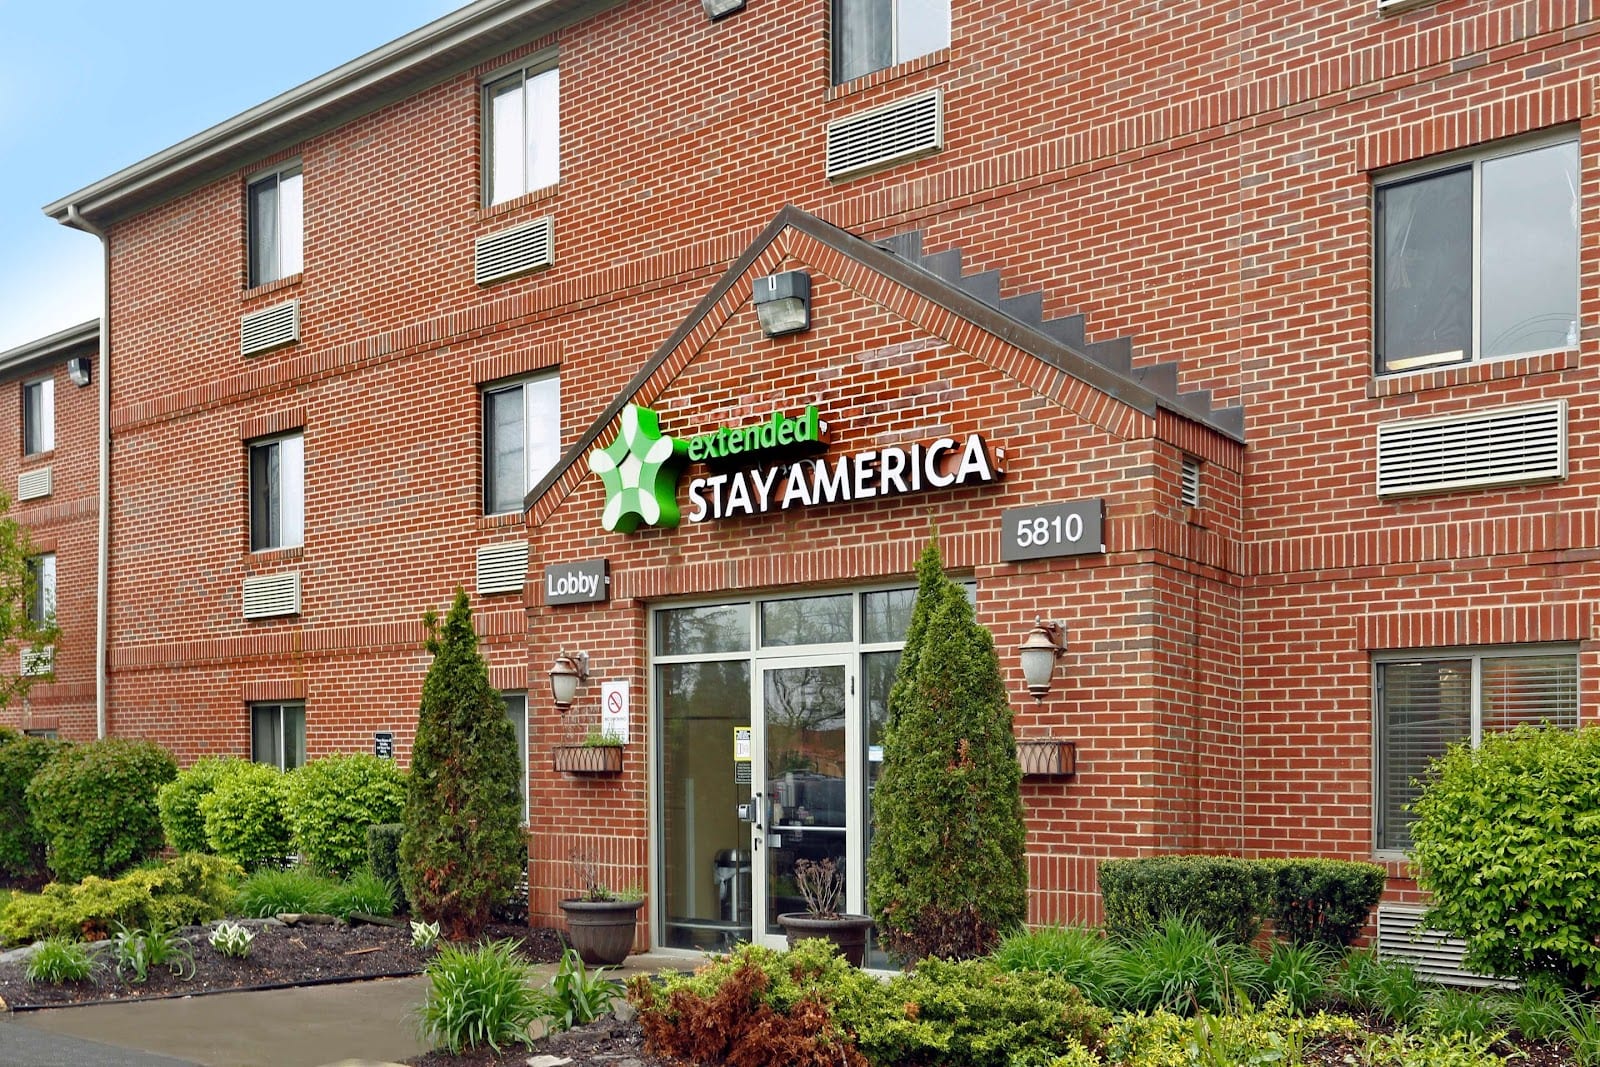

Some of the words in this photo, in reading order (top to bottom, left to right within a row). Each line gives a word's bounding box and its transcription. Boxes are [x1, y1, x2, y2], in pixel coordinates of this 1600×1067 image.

[688, 405, 815, 461] extended
[1016, 513, 1084, 547] 5810
[547, 570, 600, 598] Lobby
